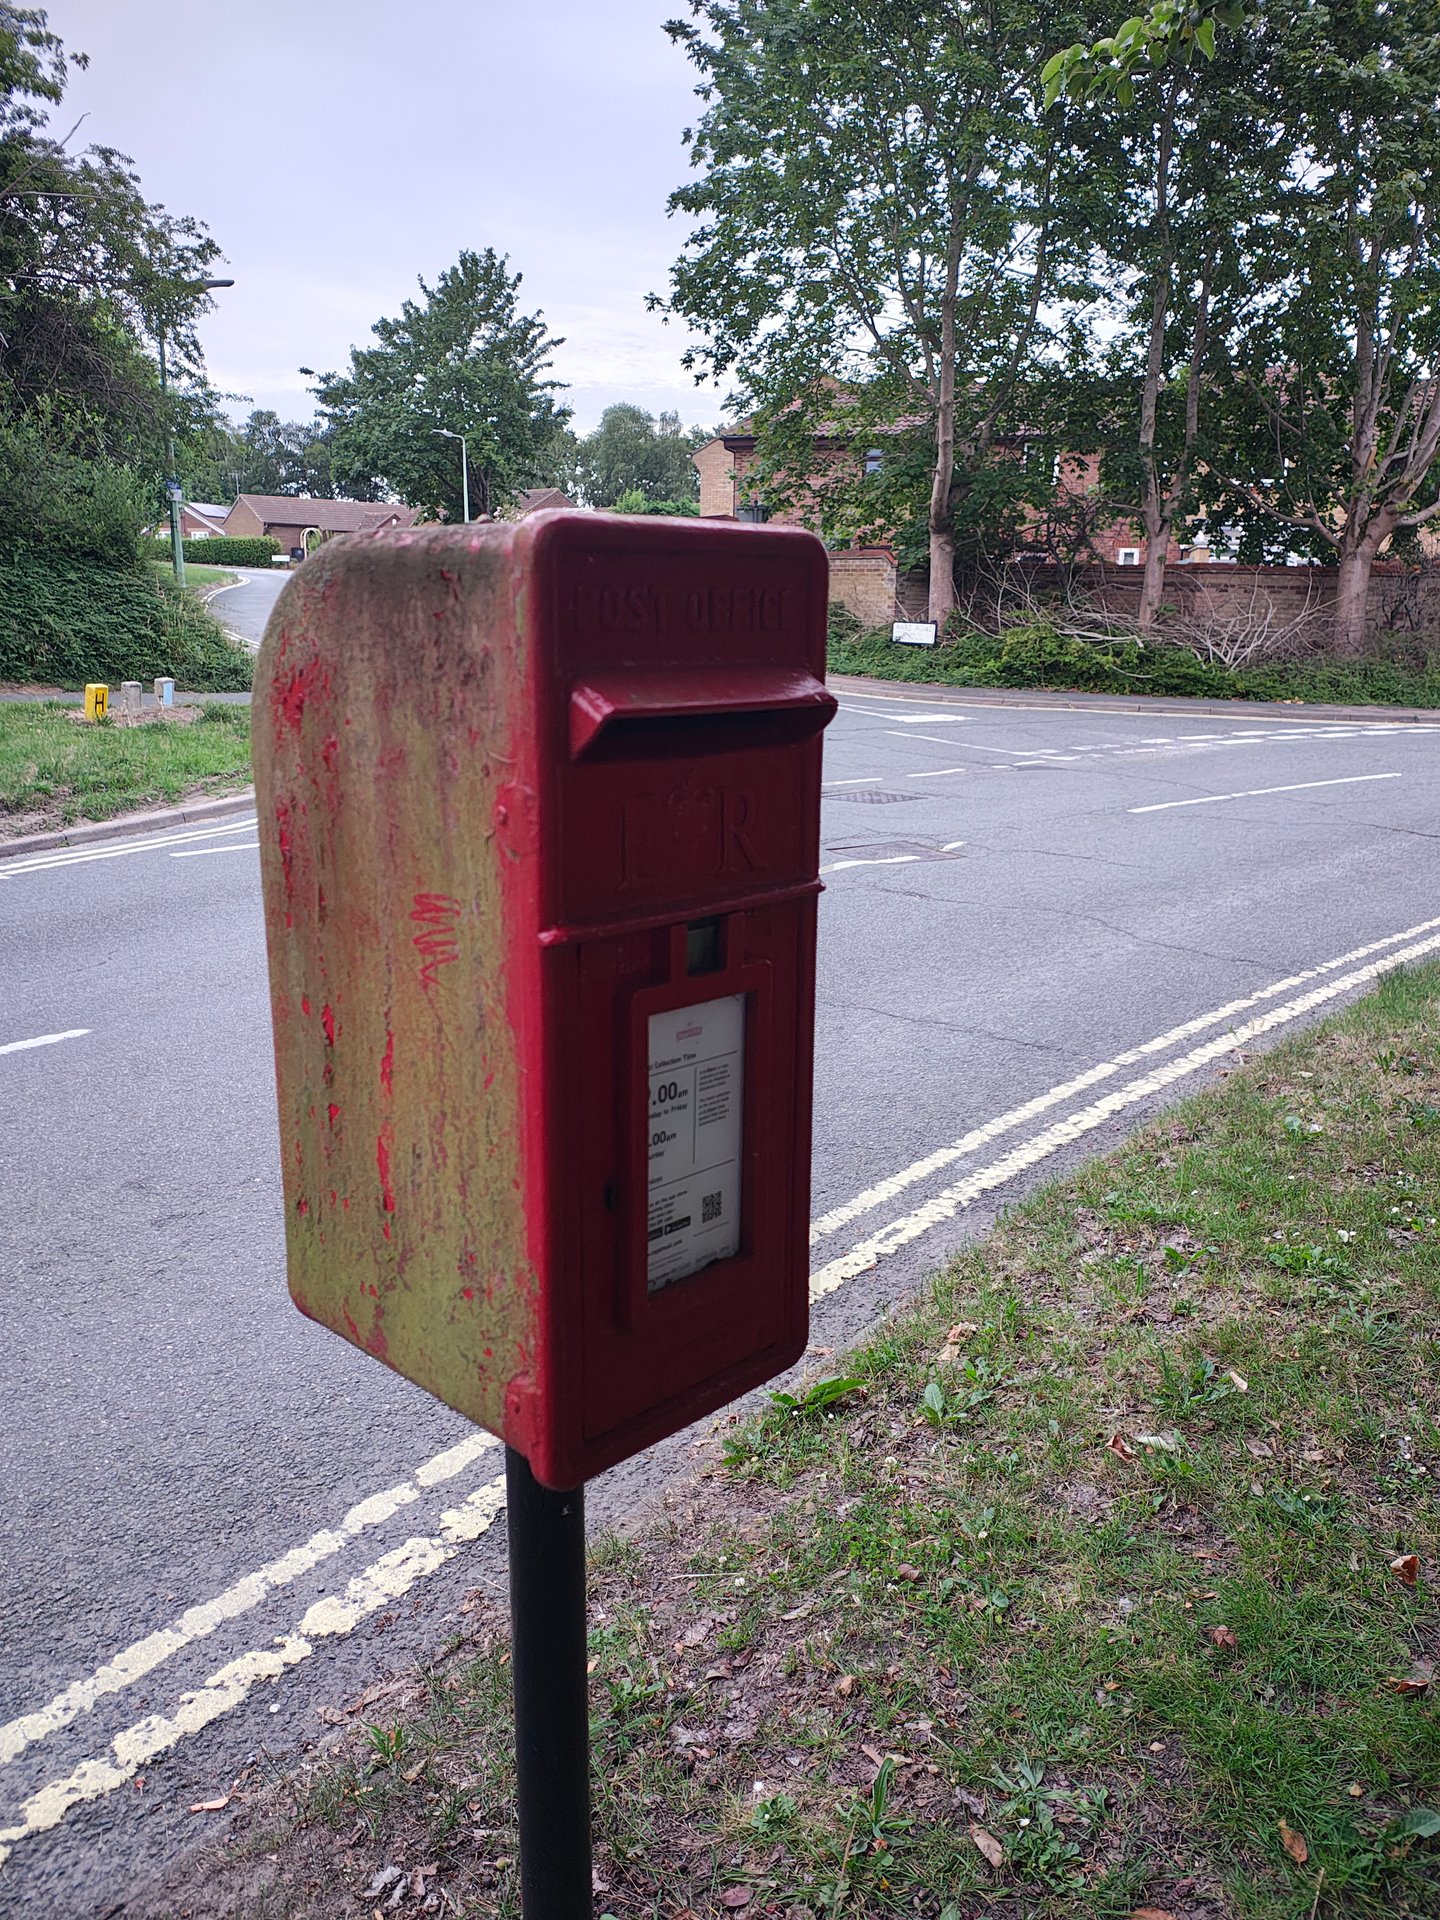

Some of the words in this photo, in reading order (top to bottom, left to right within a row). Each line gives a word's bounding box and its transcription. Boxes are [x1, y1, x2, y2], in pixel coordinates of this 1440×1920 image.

[571, 584, 666, 633] POST
[686, 584, 794, 633] OFFICE
[95, 692, 104, 713] H
[715, 785, 768, 876] R
[648, 1080, 689, 1106] .00am
[647, 1130, 678, 1148] .00am
